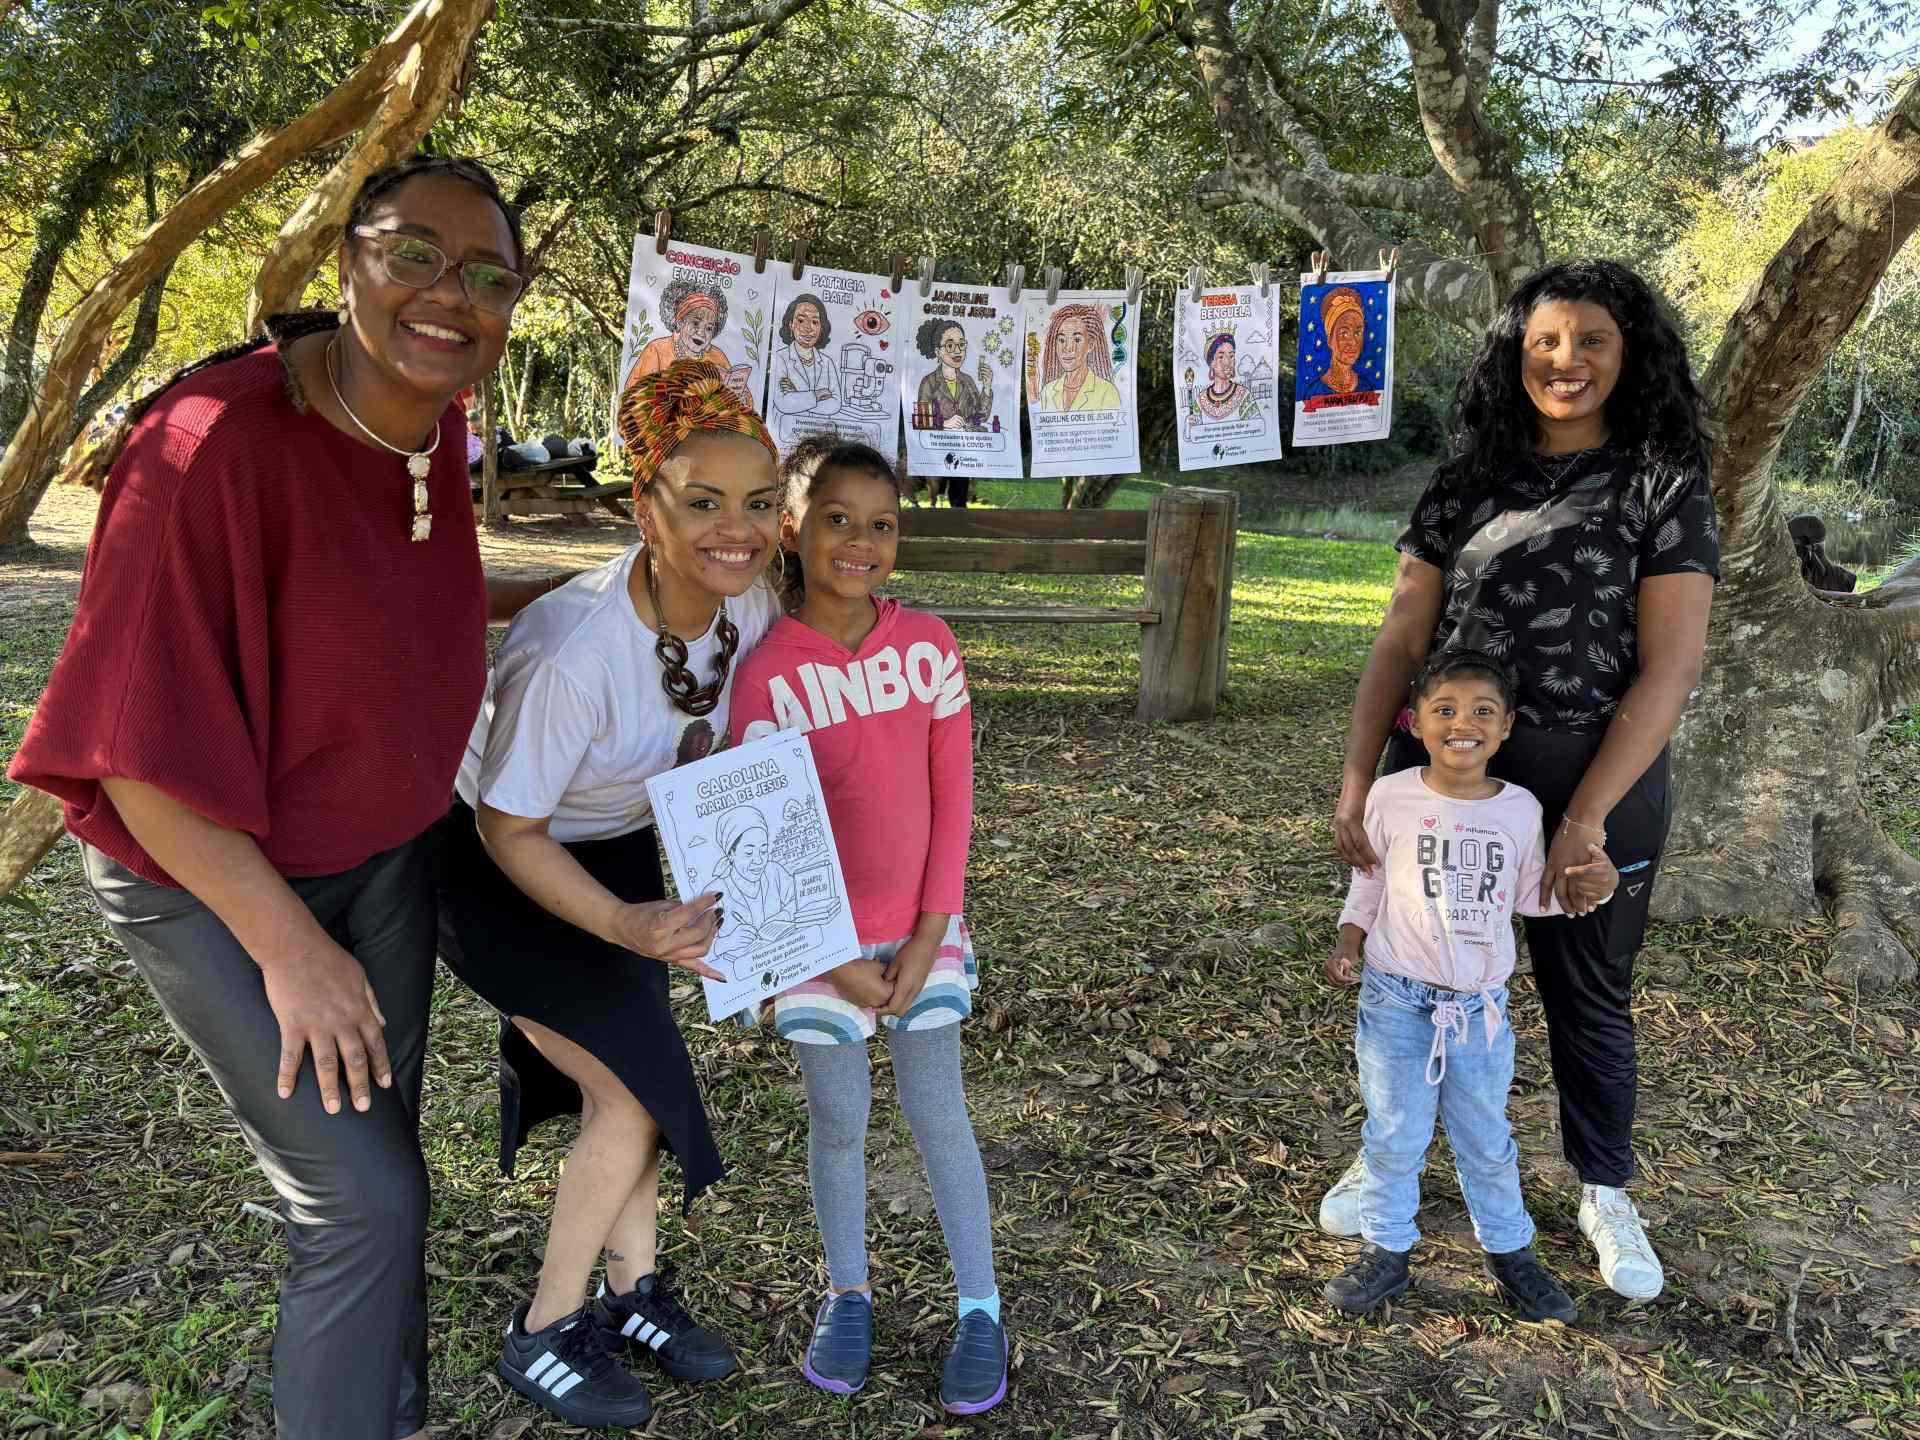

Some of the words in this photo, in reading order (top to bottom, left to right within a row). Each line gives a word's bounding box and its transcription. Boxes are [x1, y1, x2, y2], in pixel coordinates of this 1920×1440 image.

[666, 250, 741, 275] CONCEIÇÃO
[673, 266, 732, 289] EVARISTO
[812, 274, 865, 293] PATRICIA
[823, 290, 854, 305] BATH
[1201, 293, 1238, 307] TERESA
[1241, 295, 1251, 304] DE
[953, 305, 966, 317] DE
[968, 306, 996, 318] JESUS
[1200, 306, 1251, 320] BENGUELA
[697, 758, 780, 799] CAROLINA
[696, 794, 736, 818] MARIA
[737, 787, 755, 803] DE
[755, 775, 788, 797] JESUS
[1417, 834, 1505, 873] BLOG
[1422, 867, 1498, 904] GER
[1446, 908, 1490, 922] PARTY
[755, 959, 772, 969] força
[772, 953, 783, 962] das
[784, 942, 809, 959] palavras
